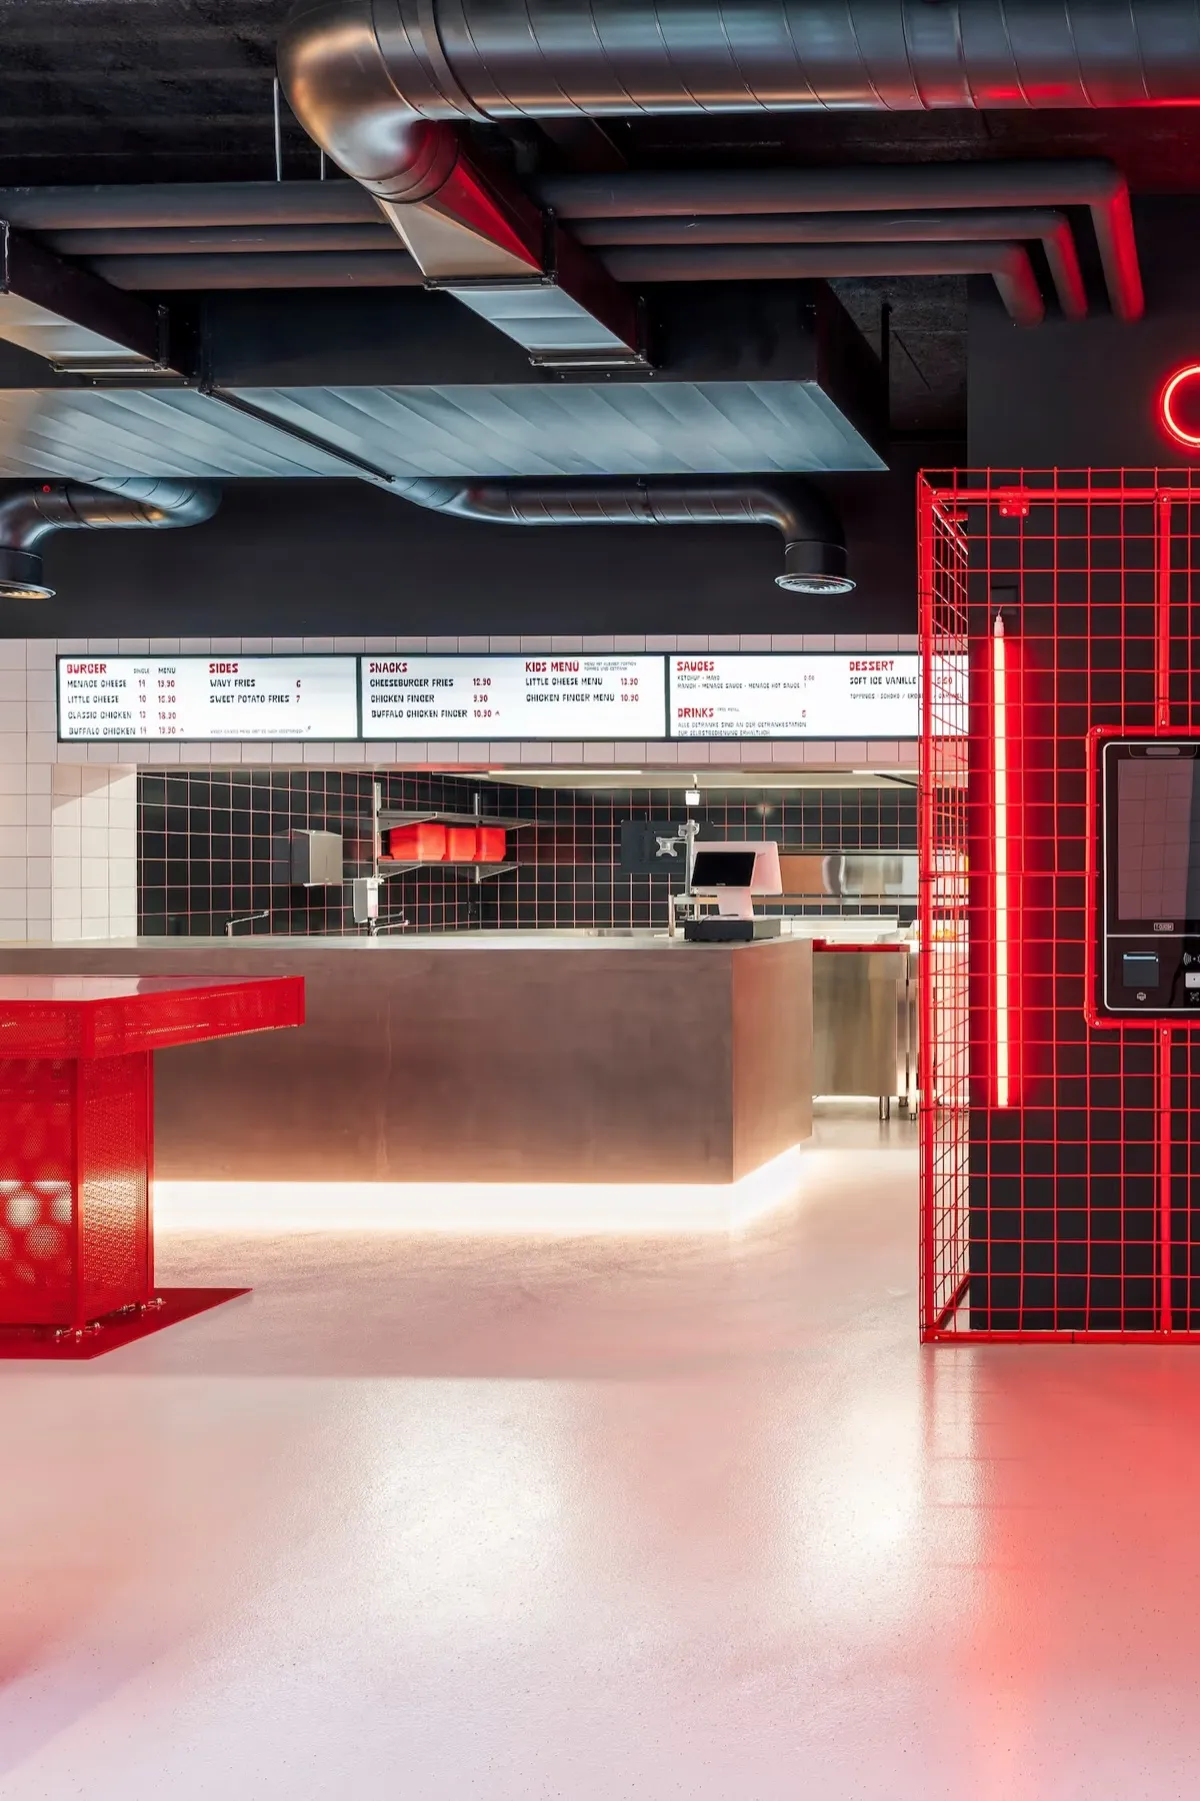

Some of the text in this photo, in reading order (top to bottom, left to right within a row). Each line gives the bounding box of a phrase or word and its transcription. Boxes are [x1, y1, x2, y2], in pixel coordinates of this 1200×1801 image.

[66, 663, 107, 674] BURGER
[209, 663, 239, 673] SIDES
[369, 662, 408, 673] SNACKS
[525, 661, 547, 672] KIDS
[676, 661, 715, 672] SAUCES
[849, 661, 894, 671] DESSERT
[67, 680, 97, 688] MENACE
[100, 680, 127, 688] CHEESE
[210, 679, 231, 687] WAVY
[234, 679, 255, 687] FRIES
[370, 678, 429, 687] CHEESEBURGER
[432, 678, 454, 687] FRIES
[525, 677, 549, 686] LITTLE
[552, 677, 579, 686] CHEESE
[581, 677, 603, 686] MENU
[850, 677, 867, 685] SOFT
[870, 677, 882, 685] ICE
[885, 677, 916, 685] VANILLE
[67, 695, 90, 703] LITTLE
[93, 695, 119, 703] CHEESE
[210, 695, 234, 703] SWEET
[237, 695, 265, 703] POTATO
[269, 695, 290, 703] FRIES
[370, 694, 404, 703] CHICKEN
[407, 694, 435, 703] FINGER
[526, 694, 560, 702] CHICKEN
[562, 694, 590, 702] FINGER
[593, 694, 615, 702] MENU
[68, 711, 97, 719] CLASSIC
[100, 711, 132, 719] CHICKEN
[371, 710, 404, 718] BUFFALO
[406, 710, 438, 718] CHICKEN
[441, 710, 468, 718] FINGER
[677, 707, 714, 718] DRINKS
[68, 727, 100, 735] BUFFALO
[103, 727, 136, 735] CHICKEN
